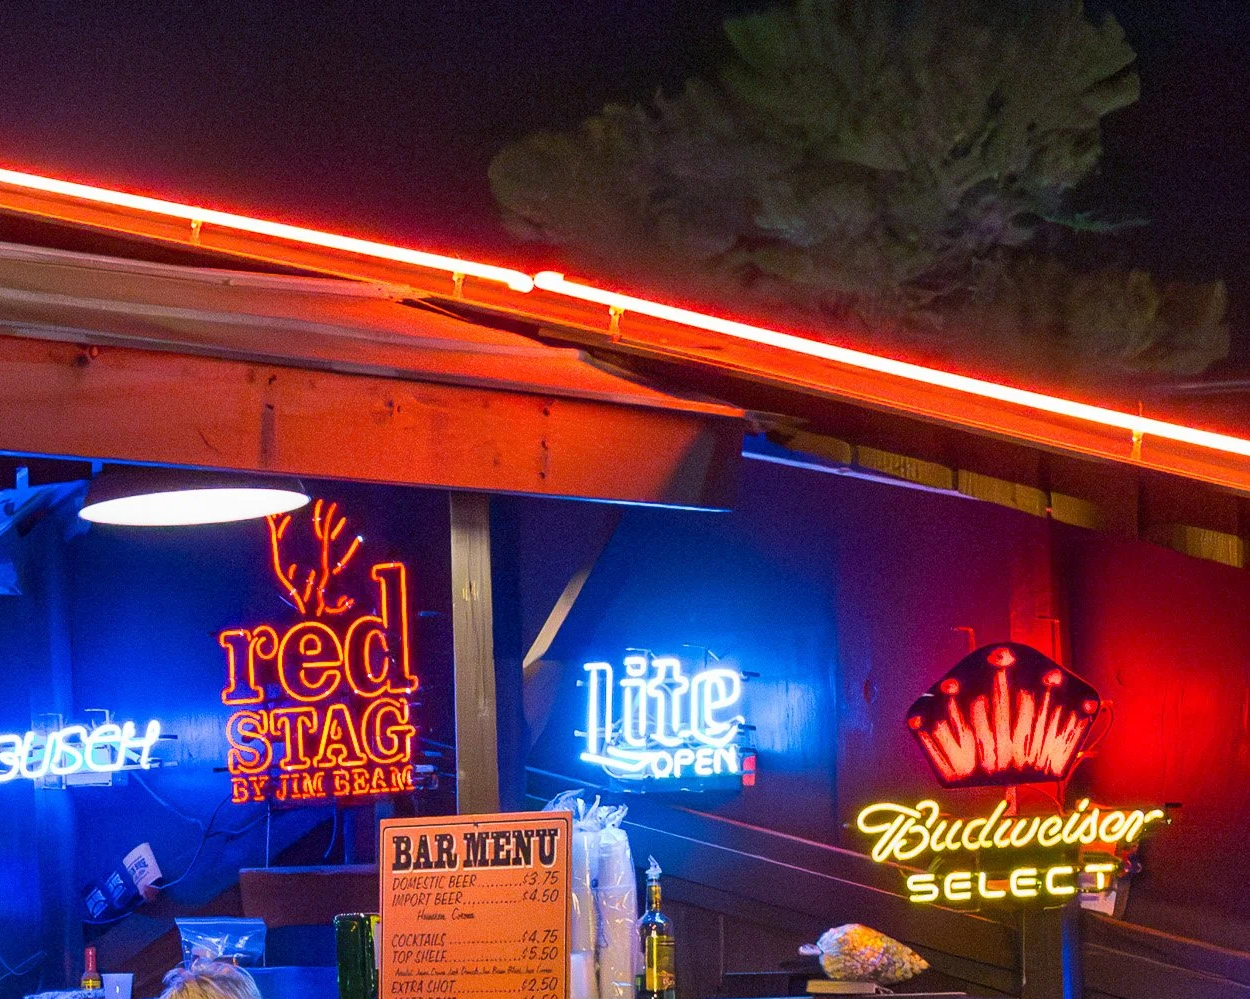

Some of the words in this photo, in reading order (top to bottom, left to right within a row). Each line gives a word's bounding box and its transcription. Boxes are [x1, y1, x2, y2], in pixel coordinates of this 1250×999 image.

[219, 562, 419, 705] red
[225, 698, 416, 775] STAG
[650, 746, 739, 779] OPEN
[231, 777, 269, 803] BY
[276, 771, 326, 799] JIM
[333, 765, 415, 796] BEAM
[856, 798, 1166, 864] Budweiser
[392, 834, 458, 872] BAR
[463, 828, 560, 869] MENU
[392, 875, 445, 891] DOMESTIC
[448, 874, 477, 888] BEER
[522, 870, 560, 886] $3.75
[392, 892, 431, 907] IMPORT
[435, 891, 463, 905] BEER
[522, 888, 560, 903] $4.50
[906, 863, 1116, 904] SELECT
[391, 933, 447, 948] COCKTAILS
[521, 929, 559, 945] $4.75
[391, 951, 414, 964] TOP
[415, 949, 447, 964] SHELF
[522, 946, 559, 961] $5.50
[391, 980, 424, 994] EXTRA
[426, 979, 455, 994] SHOT
[521, 976, 558, 992] $2.50
